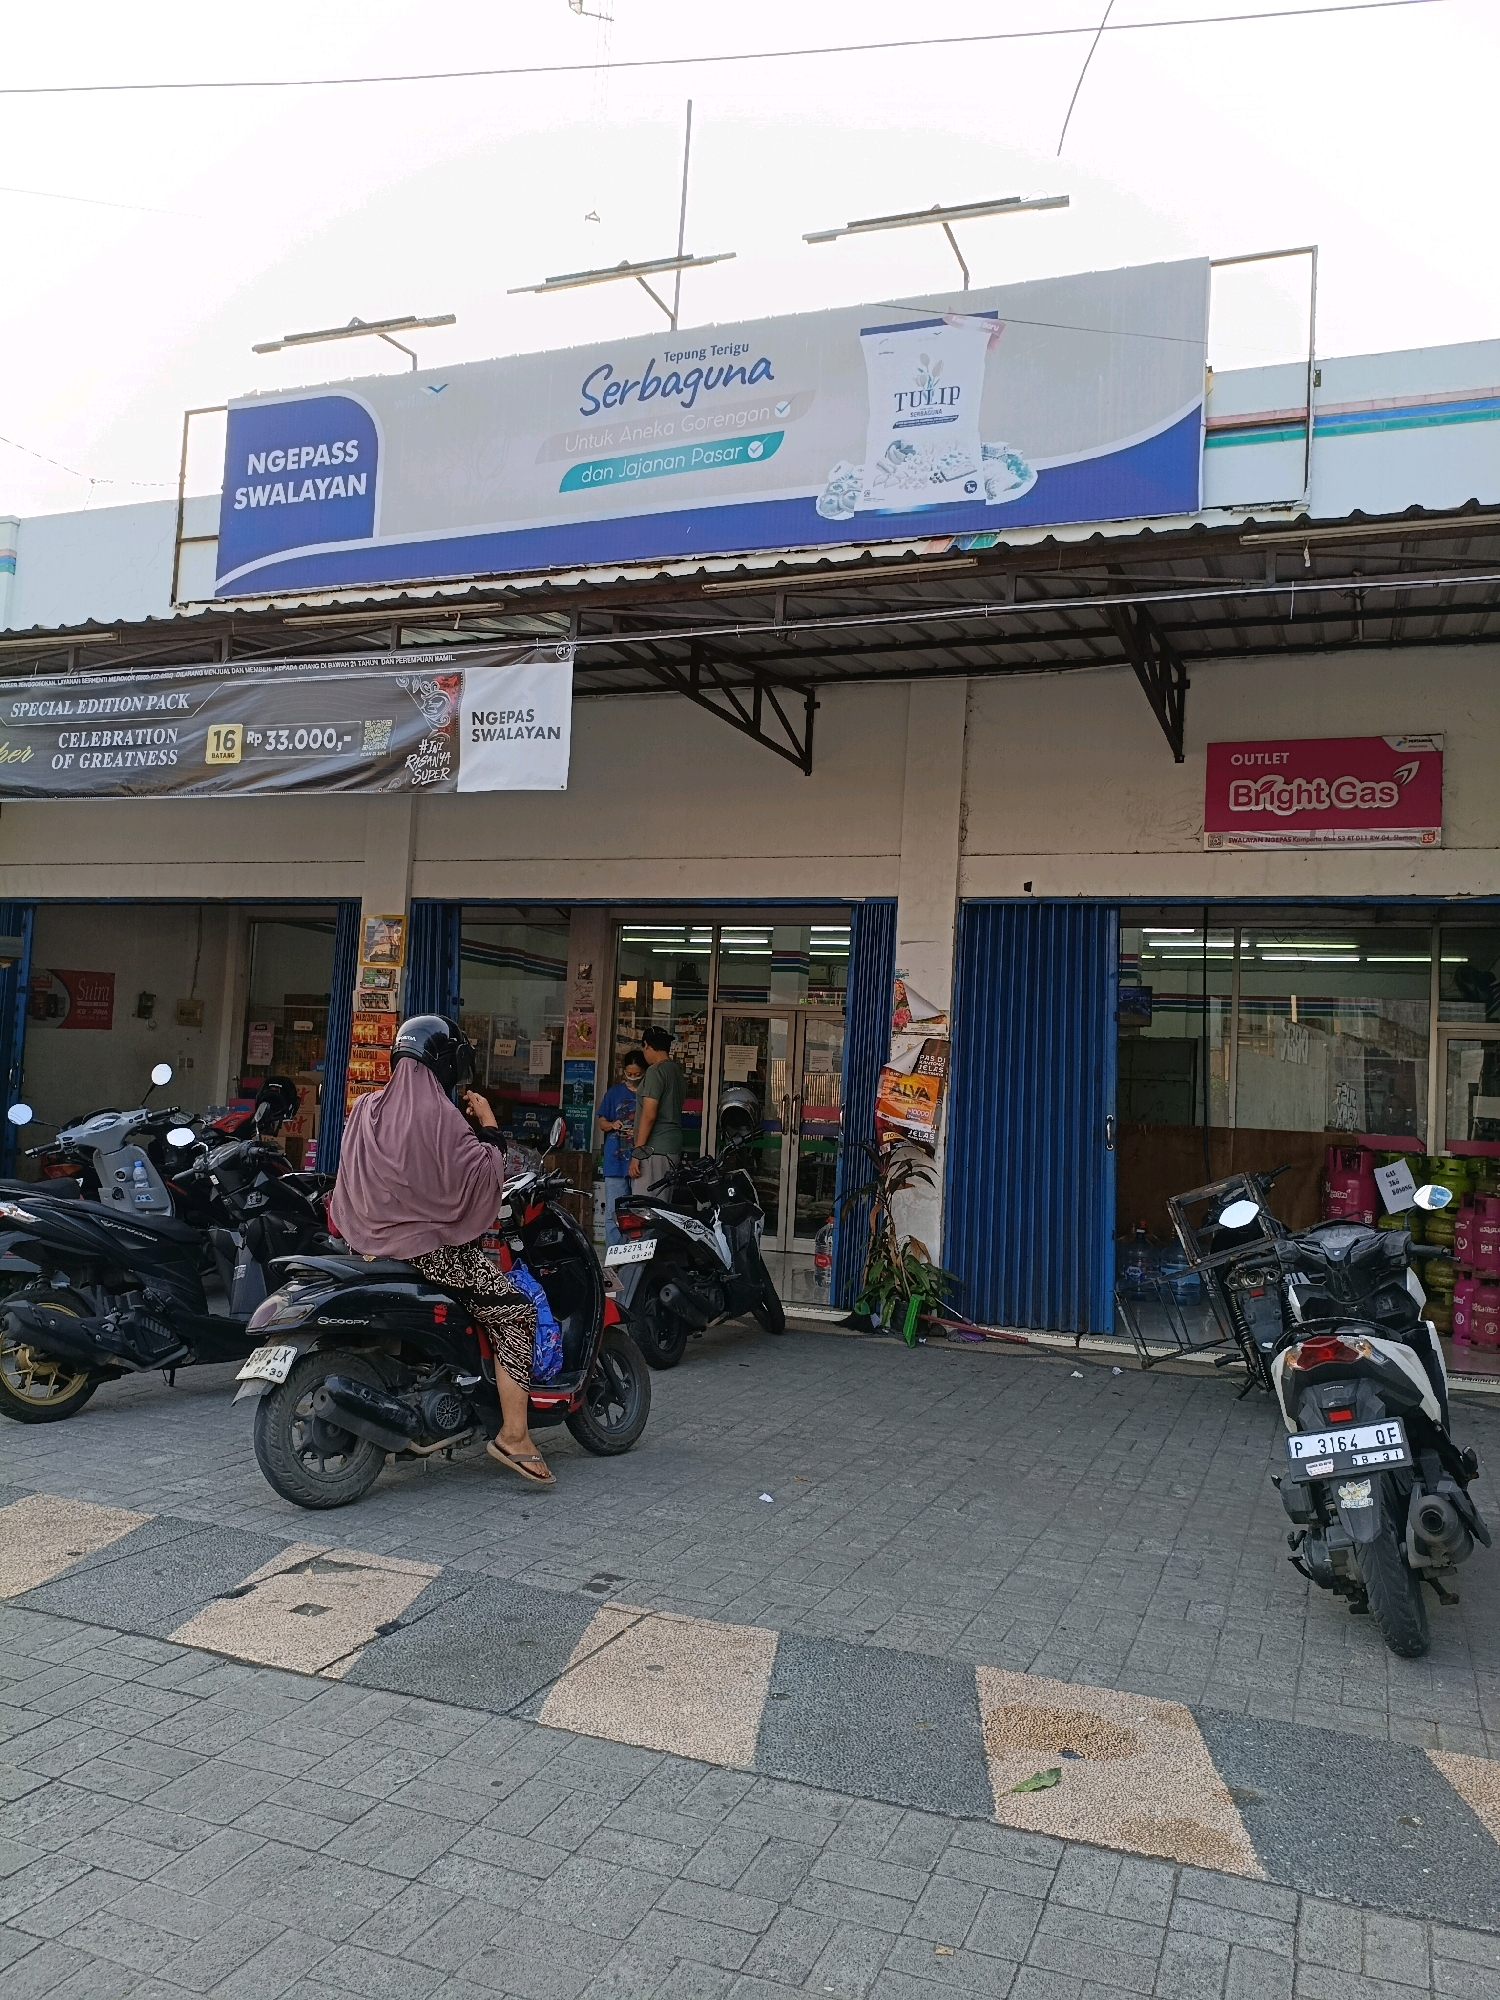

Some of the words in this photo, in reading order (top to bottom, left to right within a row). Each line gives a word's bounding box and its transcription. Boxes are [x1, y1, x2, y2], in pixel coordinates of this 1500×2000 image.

[663, 347, 708, 364] Tepung
[710, 343, 750, 356] Terigu
[579, 357, 775, 417] Serbaguna
[894, 385, 961, 413] TULIP
[910, 408, 943, 418] SERBAGUNA
[565, 432, 613, 452] Untuk
[618, 421, 675, 444] Aneka
[681, 406, 770, 432] Gorengan
[247, 439, 359, 476] NGEPASS
[581, 465, 613, 483] dan
[618, 453, 686, 478] Jajanan
[691, 444, 743, 465] Pasar
[233, 473, 367, 510] SWALAYAN
[204, 667, 231, 676] MENJUAL
[231, 666, 244, 674] DAN
[274, 664, 298, 672] KEPADA
[328, 661, 349, 669] BAWAH
[358, 659, 379, 667] TAHUN
[395, 657, 434, 665] PEREMPUAN
[10, 700, 74, 718] SPECIAL
[76, 696, 145, 714] EDITION
[146, 693, 190, 711] PACK
[471, 708, 535, 726] NGEPAS
[58, 728, 178, 749] CELEBRATION
[213, 729, 236, 752] 16
[246, 731, 263, 747] Rp
[264, 728, 352, 752] 33.000,-
[471, 726, 561, 743] SWALAYAN
[418, 738, 443, 755] #INI
[51, 753, 75, 770] OF
[79, 749, 178, 769] GREATNESS
[404, 752, 452, 772] RASANYA
[1230, 752, 1290, 766] OUTLET
[411, 767, 451, 785] SUPER
[1230, 776, 1331, 815] Bright
[1331, 777, 1399, 809] Gas
[1228, 836, 1263, 844] SWALAYAN
[76, 978, 110, 1002] Sutra
[355, 1013, 382, 1023] MARCOPOLO
[919, 1054, 935, 1062] PAS
[918, 1064, 944, 1073] JELAS
[908, 1129, 935, 1140] JELAS
[1385, 1169, 1397, 1178] GAS
[273, 1348, 292, 1364] LX
[1294, 1441, 1303, 1458] P
[1317, 1433, 1358, 1454] 3164
[1375, 1426, 1397, 1445] QF
